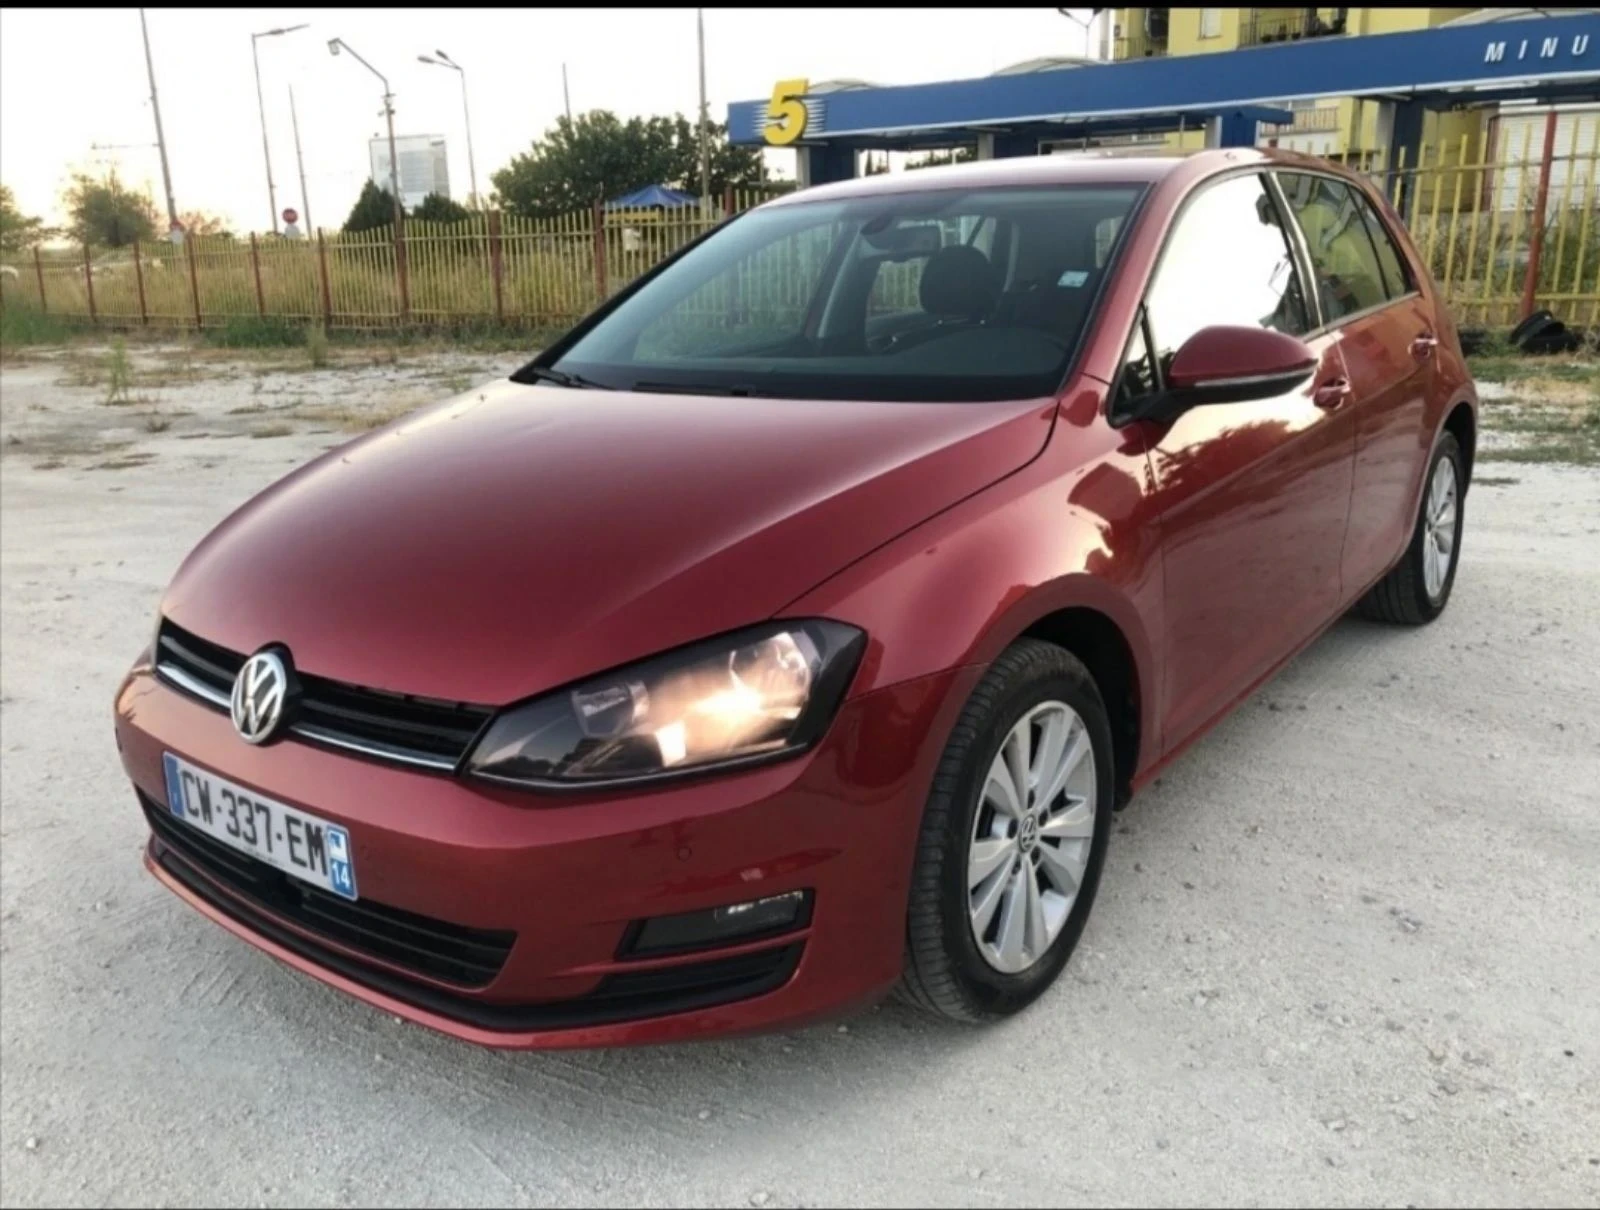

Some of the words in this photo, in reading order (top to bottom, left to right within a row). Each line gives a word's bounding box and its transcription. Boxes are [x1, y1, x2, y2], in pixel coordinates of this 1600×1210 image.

[1484, 34, 1589, 63] MINU
[763, 78, 809, 146] 5
[231, 652, 287, 744] VW
[332, 861, 351, 889] 14
